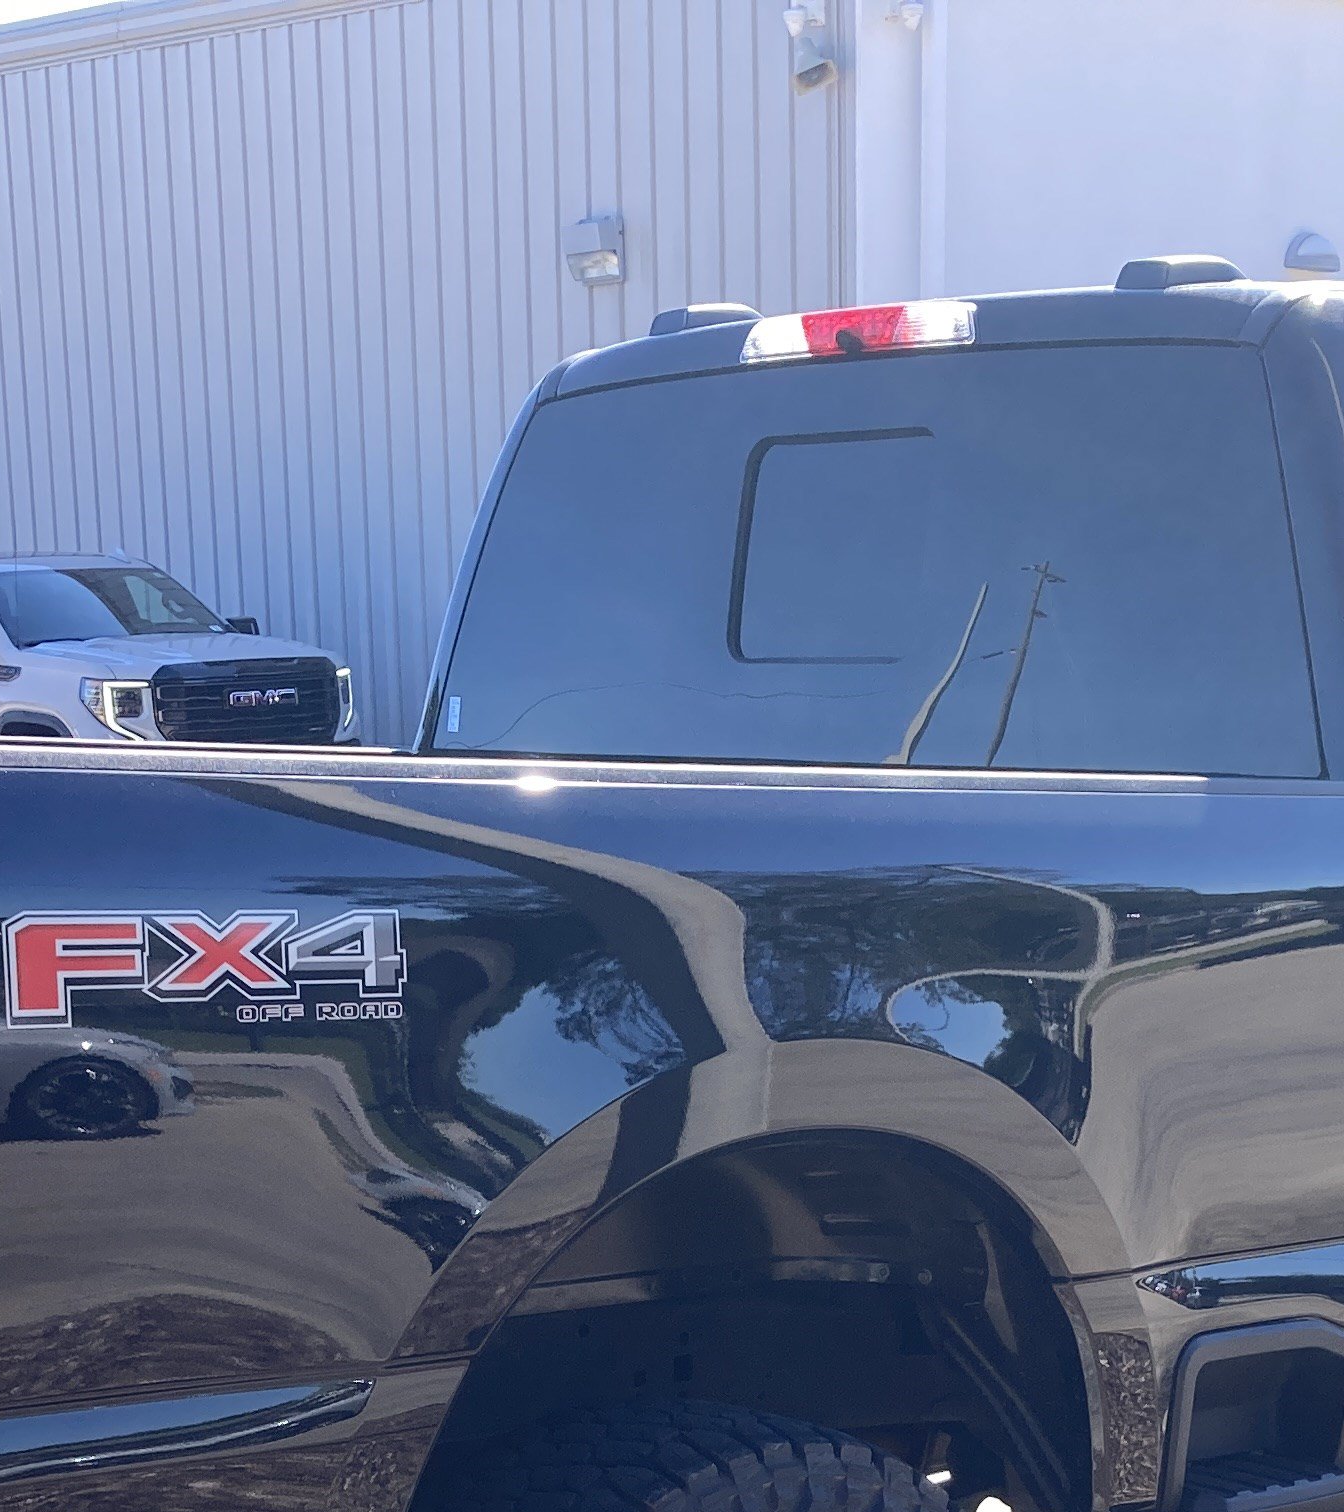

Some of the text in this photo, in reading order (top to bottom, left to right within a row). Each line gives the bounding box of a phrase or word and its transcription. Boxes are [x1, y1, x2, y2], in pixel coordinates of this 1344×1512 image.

[229, 686, 298, 707] GMC
[2, 908, 408, 1030] FX4
[236, 1001, 403, 1023] OFF ROAD
